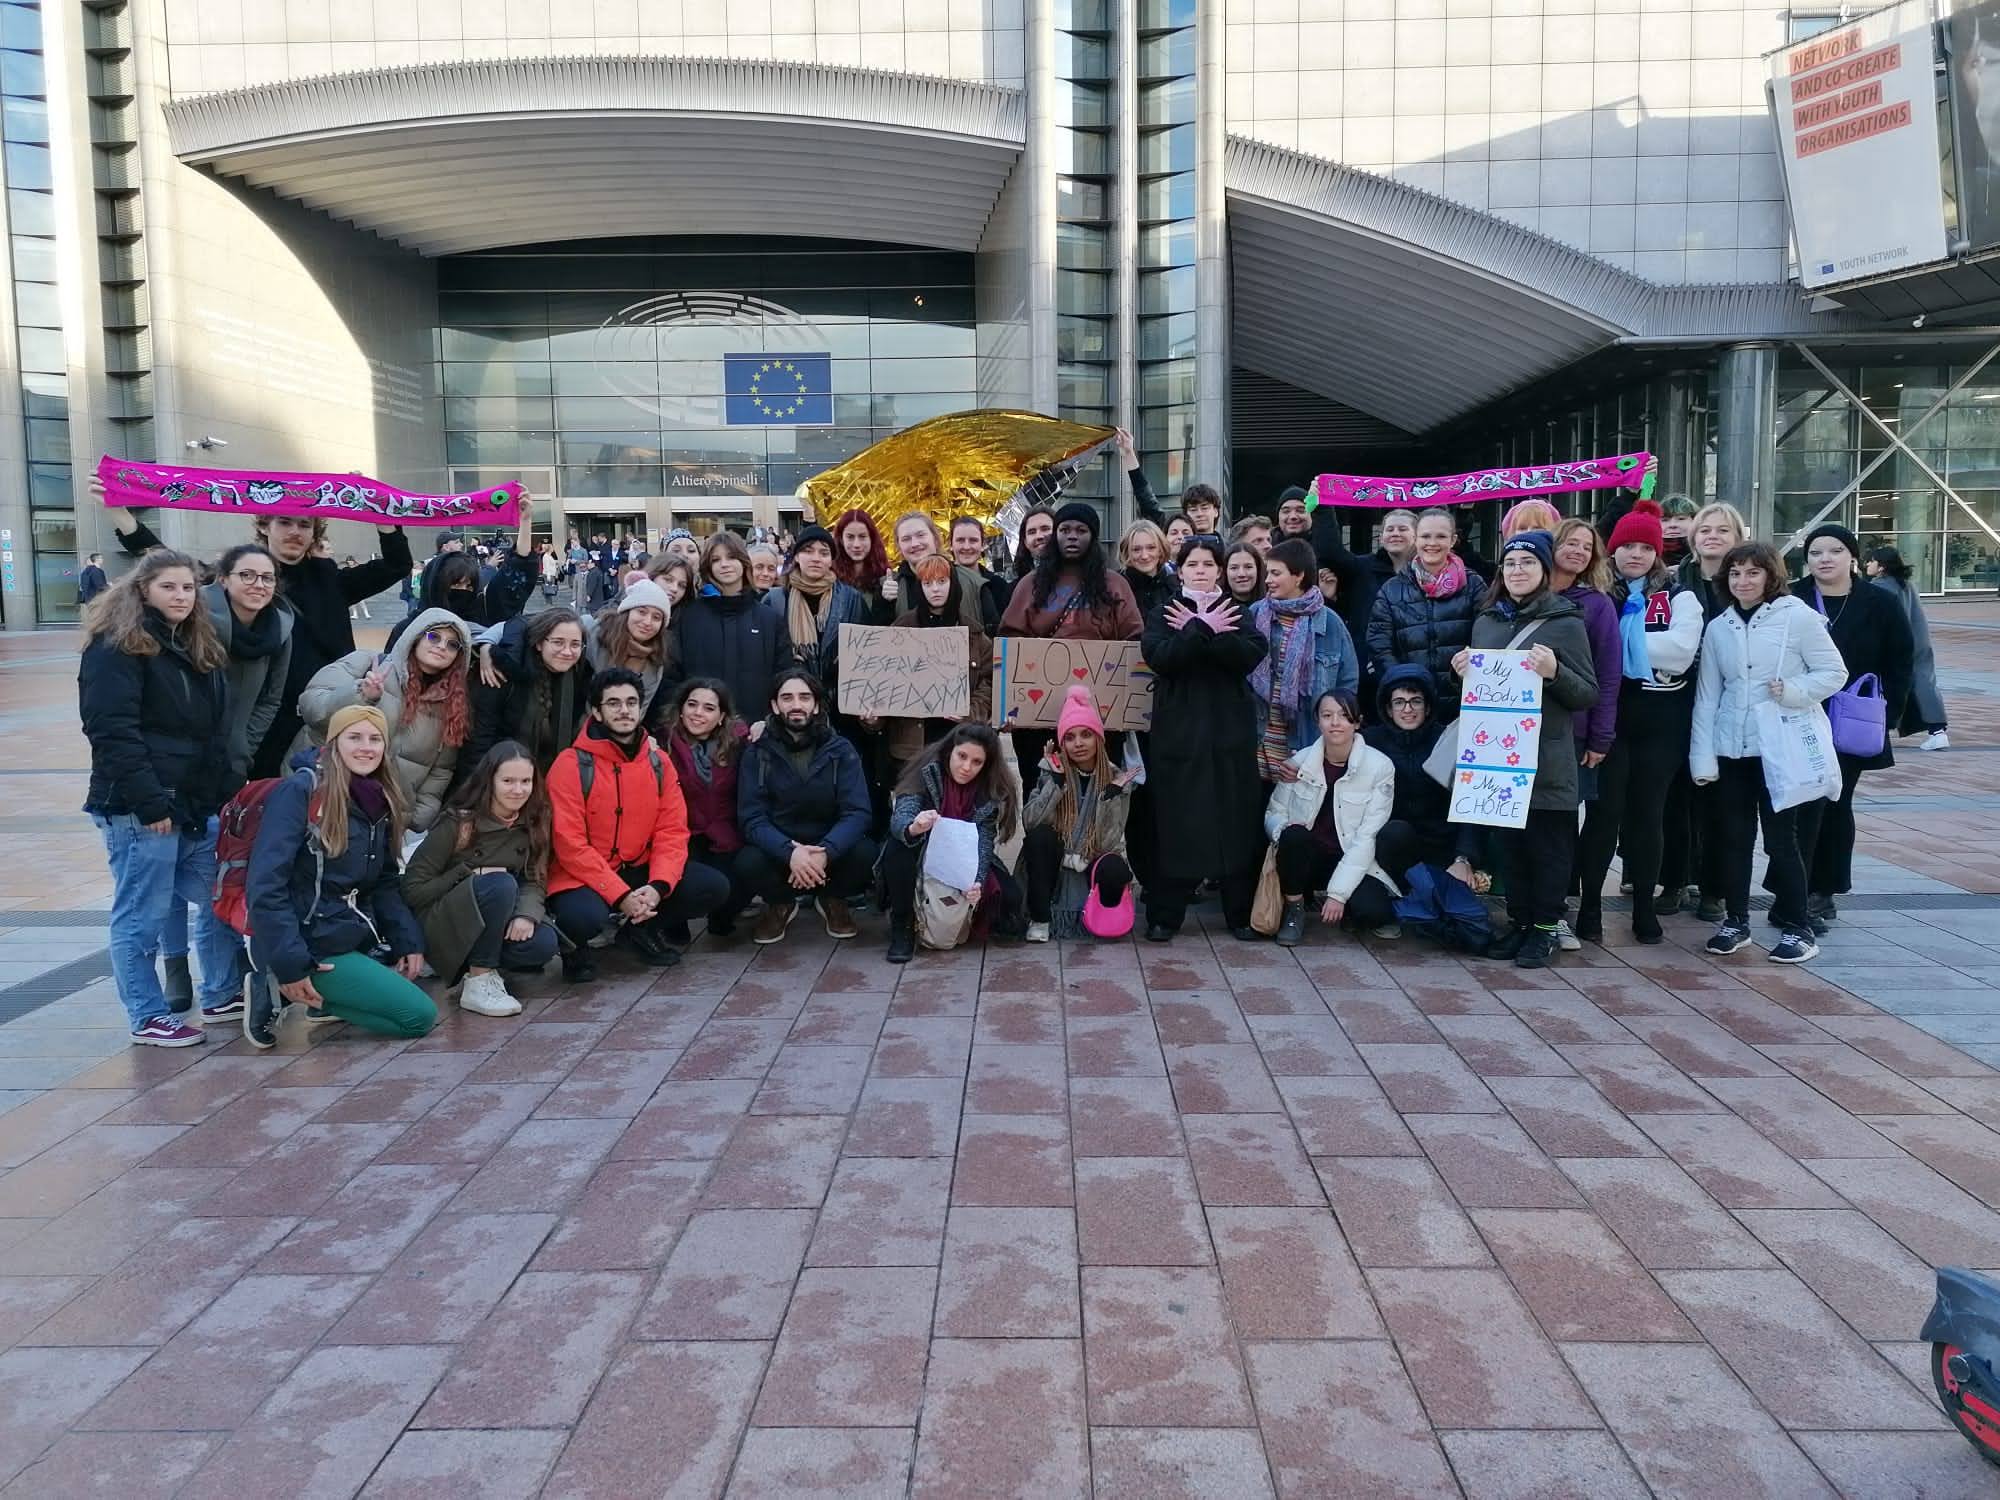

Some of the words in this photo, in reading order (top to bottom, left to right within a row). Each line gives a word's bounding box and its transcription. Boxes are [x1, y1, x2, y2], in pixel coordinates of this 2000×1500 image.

[1793, 33, 1859, 72] NETWORK
[1795, 76, 1823, 99] AND
[1825, 48, 1898, 88] CO-CREATE
[1798, 103, 1830, 127] WITH
[1834, 85, 1879, 114] YOUTH
[1800, 105, 1907, 153] ORGANISATIONS
[1839, 255, 1866, 271] YOUTH
[1867, 246, 1910, 266] NETWORK
[671, 474, 712, 488] Altiero
[714, 472, 758, 489] Spinelli
[1645, 591, 1672, 624] A
[847, 627, 887, 650] WE
[851, 654, 928, 675] DESERVE
[1012, 641, 1138, 687] LOVE
[1482, 659, 1512, 686] My
[1013, 687, 1027, 703] IS
[1035, 689, 1148, 725] LVE
[1475, 684, 1520, 706] Body
[1473, 776, 1501, 799] My
[1455, 797, 1522, 818] CHOICE
